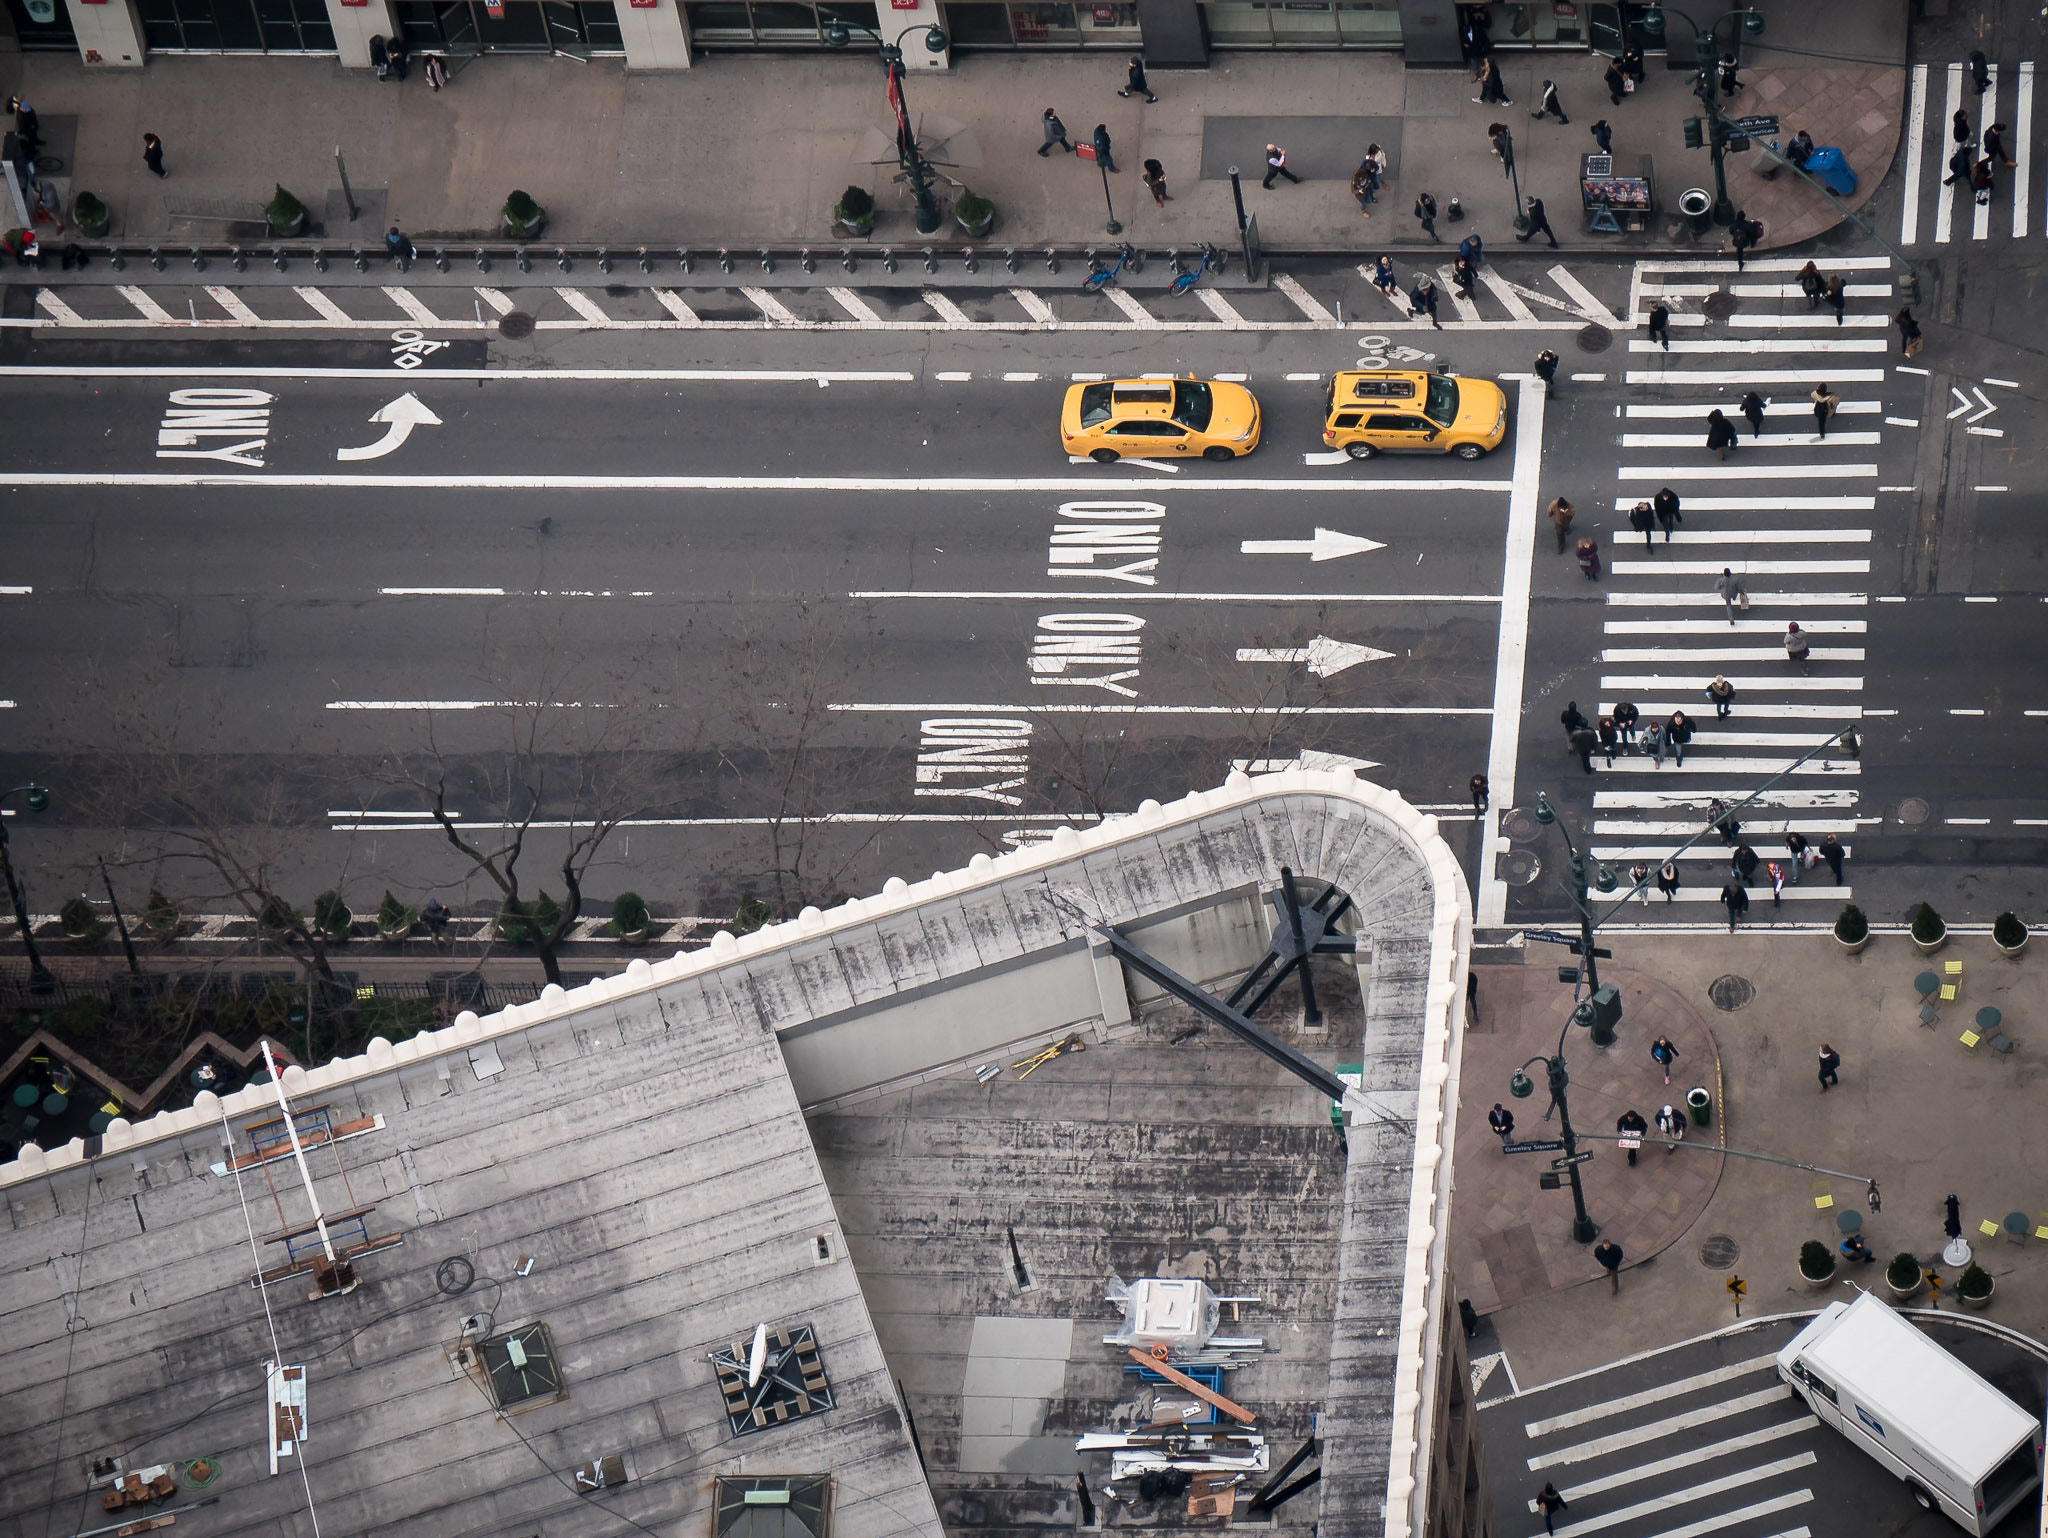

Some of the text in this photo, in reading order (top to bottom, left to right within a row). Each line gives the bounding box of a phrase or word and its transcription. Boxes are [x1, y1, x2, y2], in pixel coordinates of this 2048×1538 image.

[156, 388, 275, 468] ONLY
[1047, 501, 1166, 587] ONLY
[1027, 613, 1146, 699] ONLY
[914, 718, 1034, 807] ONLY
[1525, 932, 1551, 941] Greeley
[1552, 936, 1577, 944] Square
